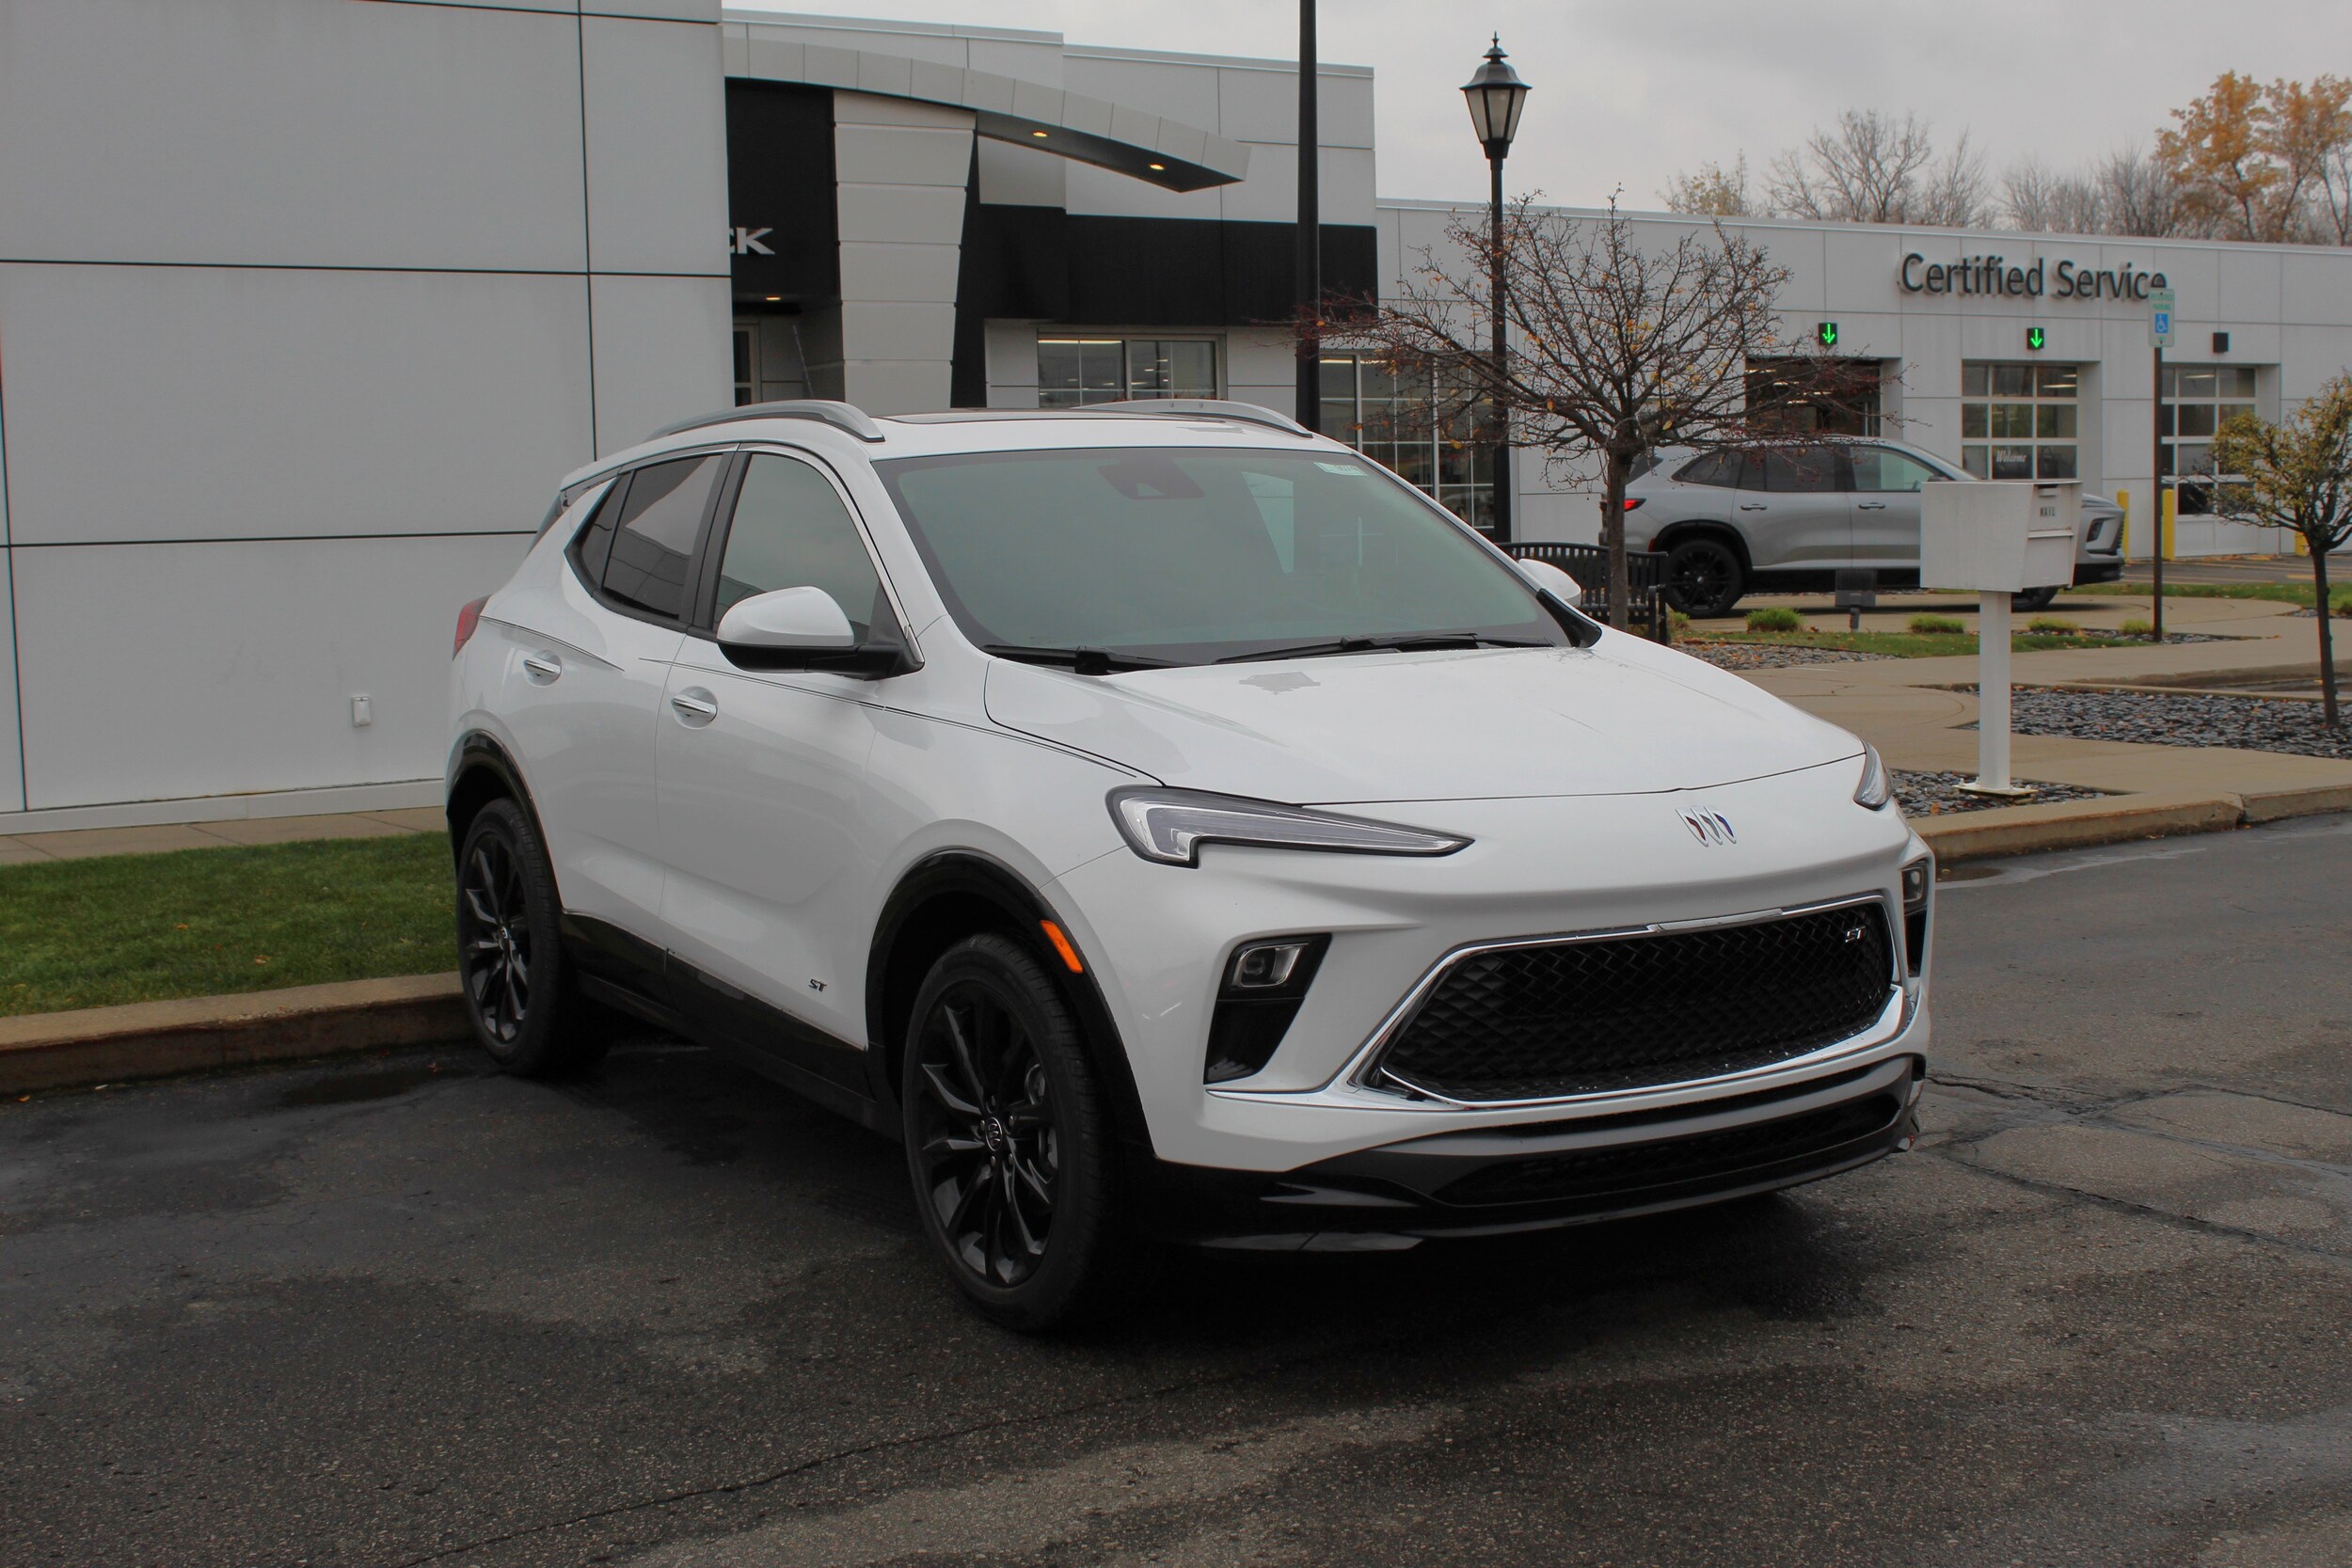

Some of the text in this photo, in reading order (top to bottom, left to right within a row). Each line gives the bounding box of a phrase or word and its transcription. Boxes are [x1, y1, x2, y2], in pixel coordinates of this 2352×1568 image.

[729, 227, 775, 254] K
[1899, 252, 2168, 300] Certified Service
[2039, 507, 2056, 517] MAIL
[1845, 926, 1866, 942] ST
[808, 978, 827, 992] ST
